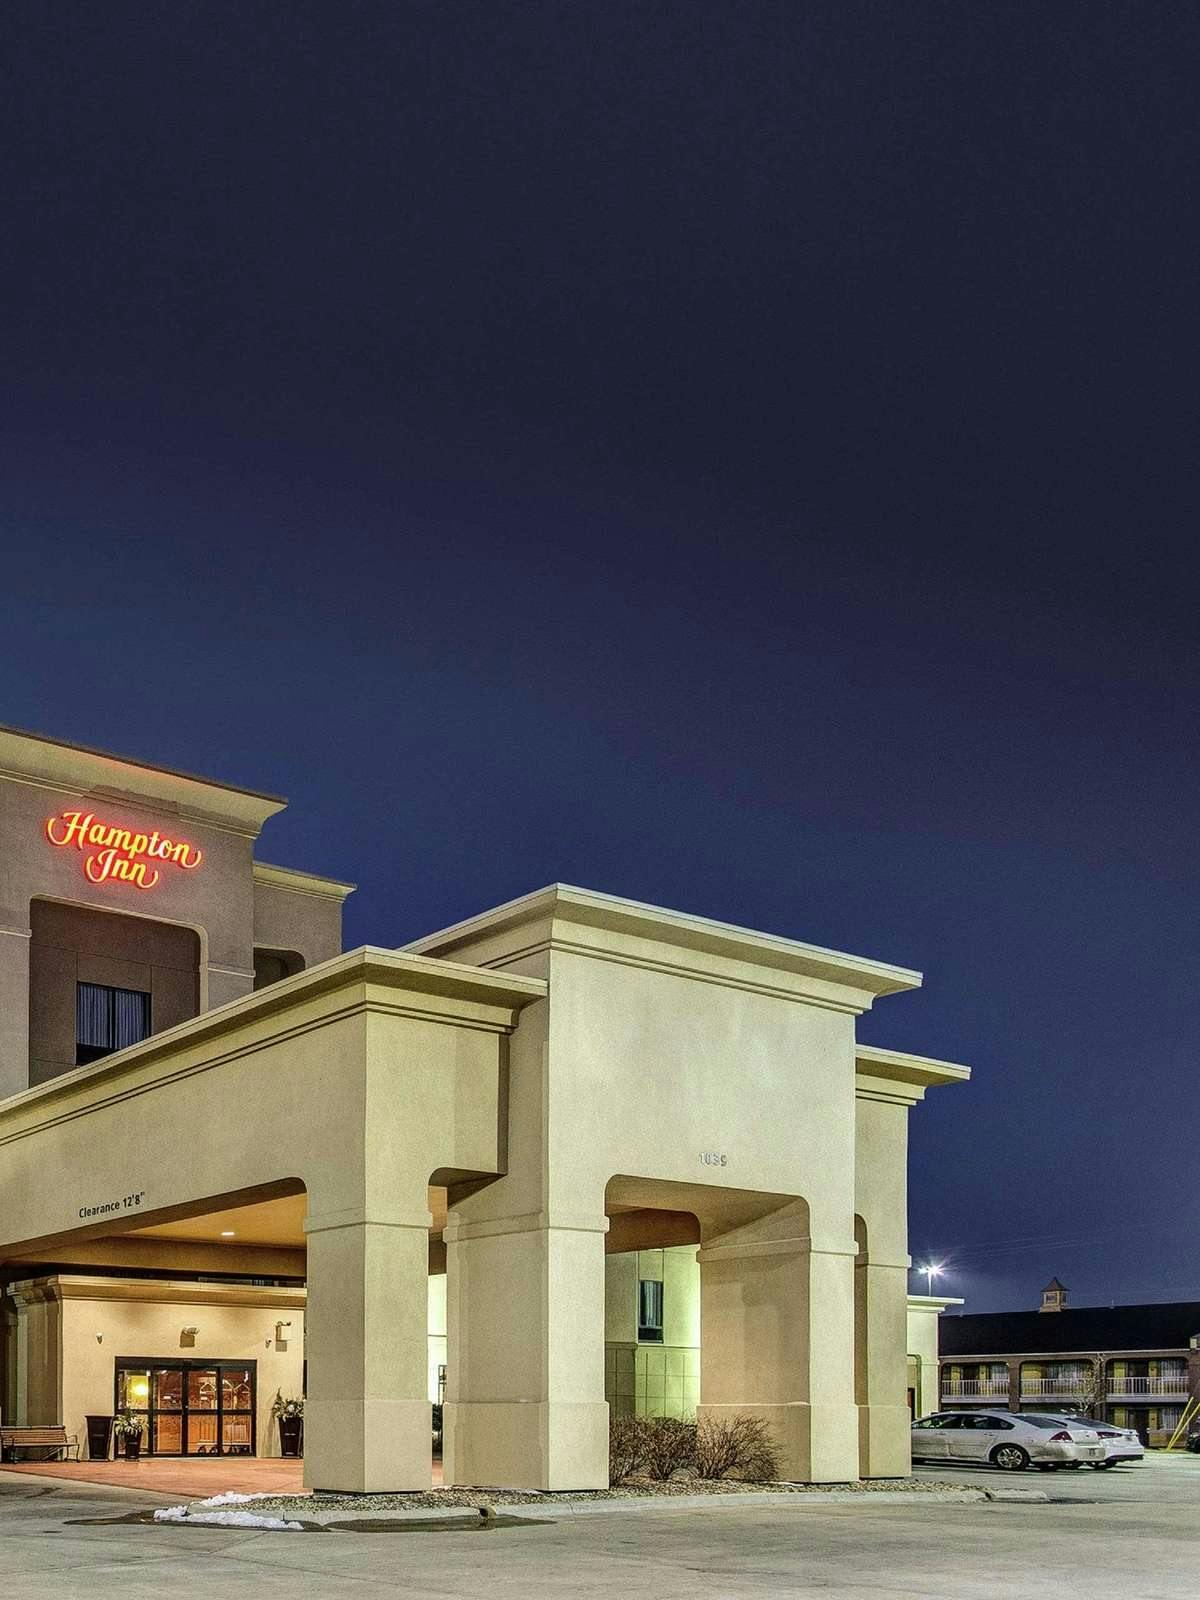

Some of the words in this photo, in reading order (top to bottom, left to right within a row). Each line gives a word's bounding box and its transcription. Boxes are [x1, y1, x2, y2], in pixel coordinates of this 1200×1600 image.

[46, 811, 202, 869] Hampton
[85, 848, 160, 890] Inn
[79, 1201, 121, 1218] Clearance
